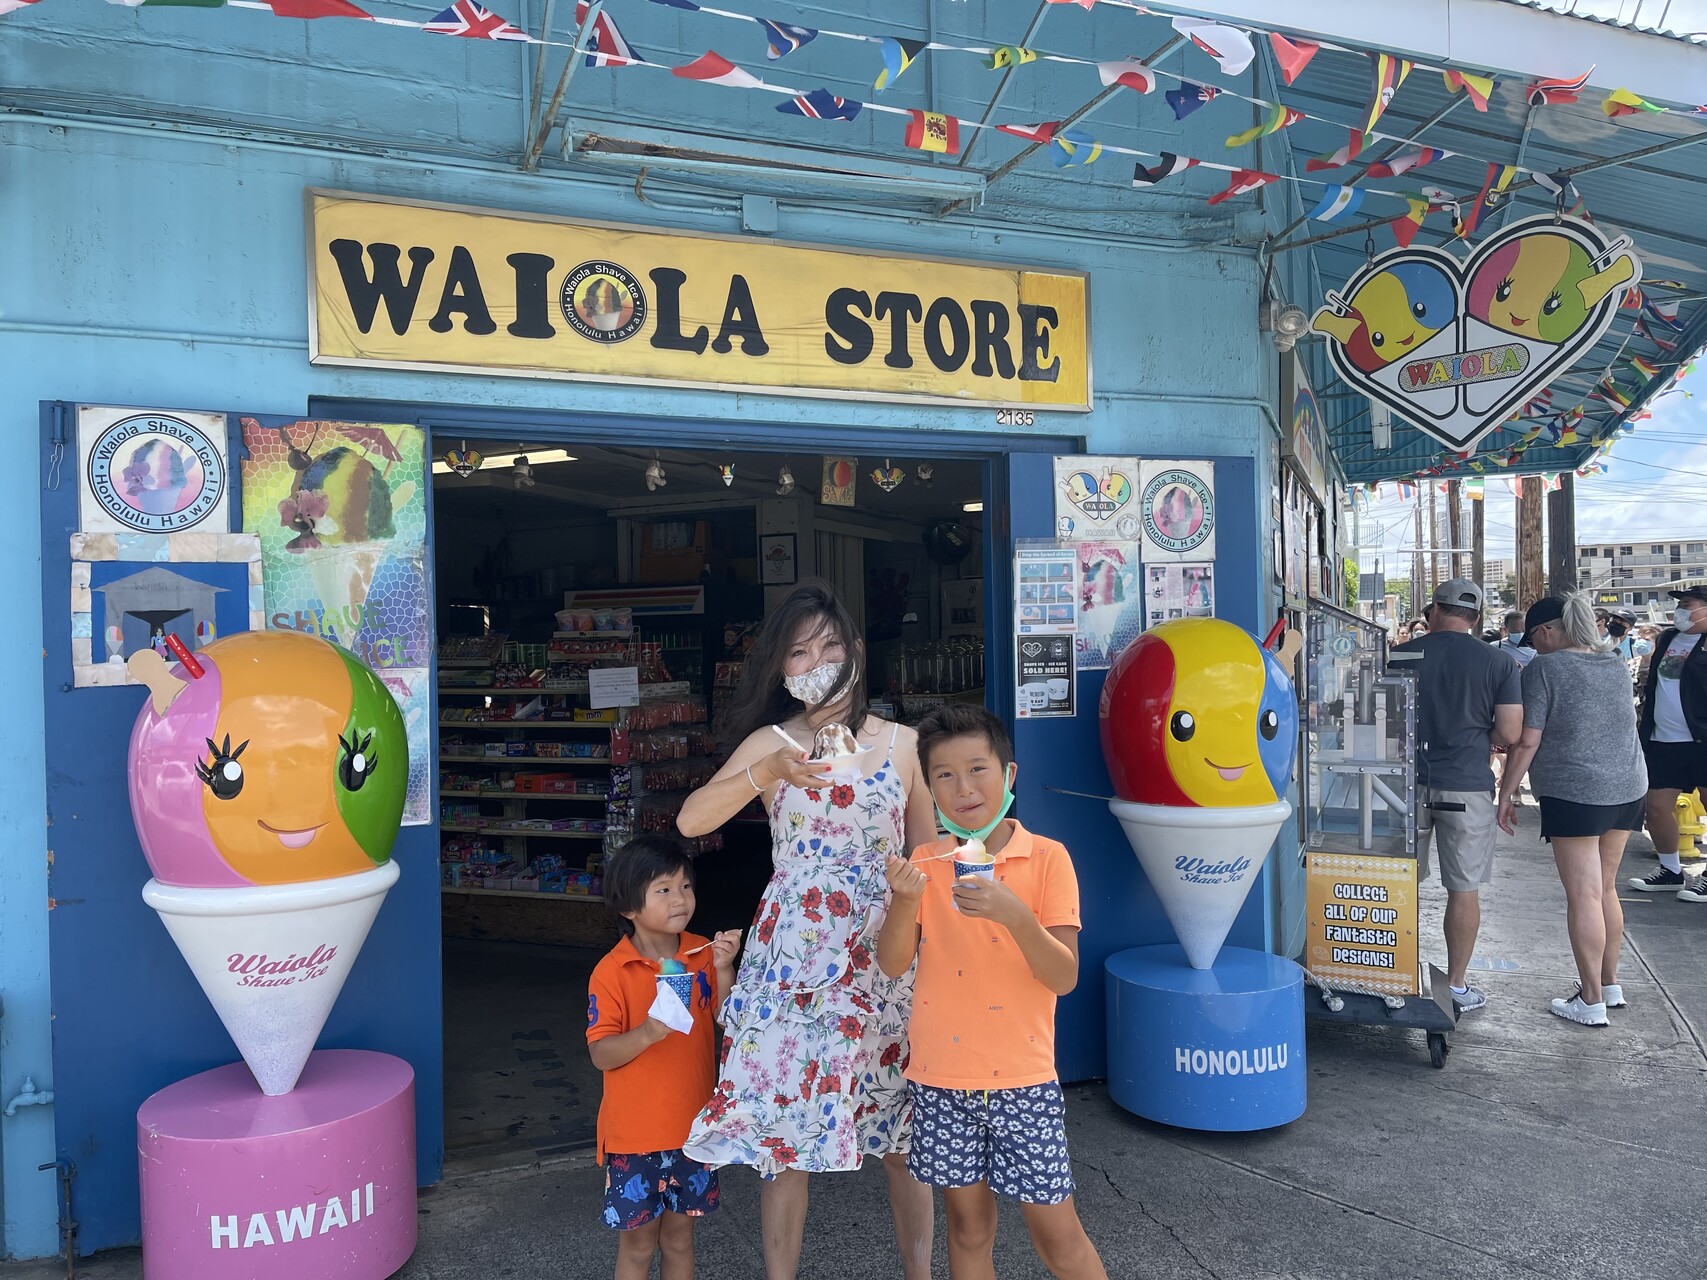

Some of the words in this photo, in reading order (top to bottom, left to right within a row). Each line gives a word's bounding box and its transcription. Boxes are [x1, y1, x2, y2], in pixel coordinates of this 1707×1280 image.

[565, 268, 591, 295] Waiola
[595, 264, 626, 282] Shave
[627, 282, 639, 299] Ice
[565, 303, 602, 339] Honolulu
[607, 306, 644, 339] Hawaii
[824, 287, 1061, 383] STORE
[1407, 347, 1521, 387] WAIOLA
[996, 409, 1034, 427] 2135
[97, 424, 139, 461] Waiola
[147, 420, 194, 445] Shave
[196, 445, 213, 468] Ice
[95, 473, 151, 527] Honolulu
[160, 479, 219, 527] Hawaii
[1145, 478, 1167, 504] Waiola
[1170, 474, 1198, 489] Shave
[1198, 489, 1208, 504] Ice
[1144, 513, 1176, 548] Honolulu
[1180, 512, 1212, 548] Hawaii
[360, 634, 414, 668] ICE
[1044, 666, 1068, 674] HERE!
[1174, 854, 1251, 875] Waiola
[1180, 872, 1222, 885] Shave
[1224, 872, 1245, 884] Ice
[226, 943, 339, 976] Waiola
[236, 973, 295, 988] Shave
[298, 965, 329, 984] Ice
[1175, 1043, 1289, 1076] HONOLULU
[210, 1182, 374, 1250] HAWAII
